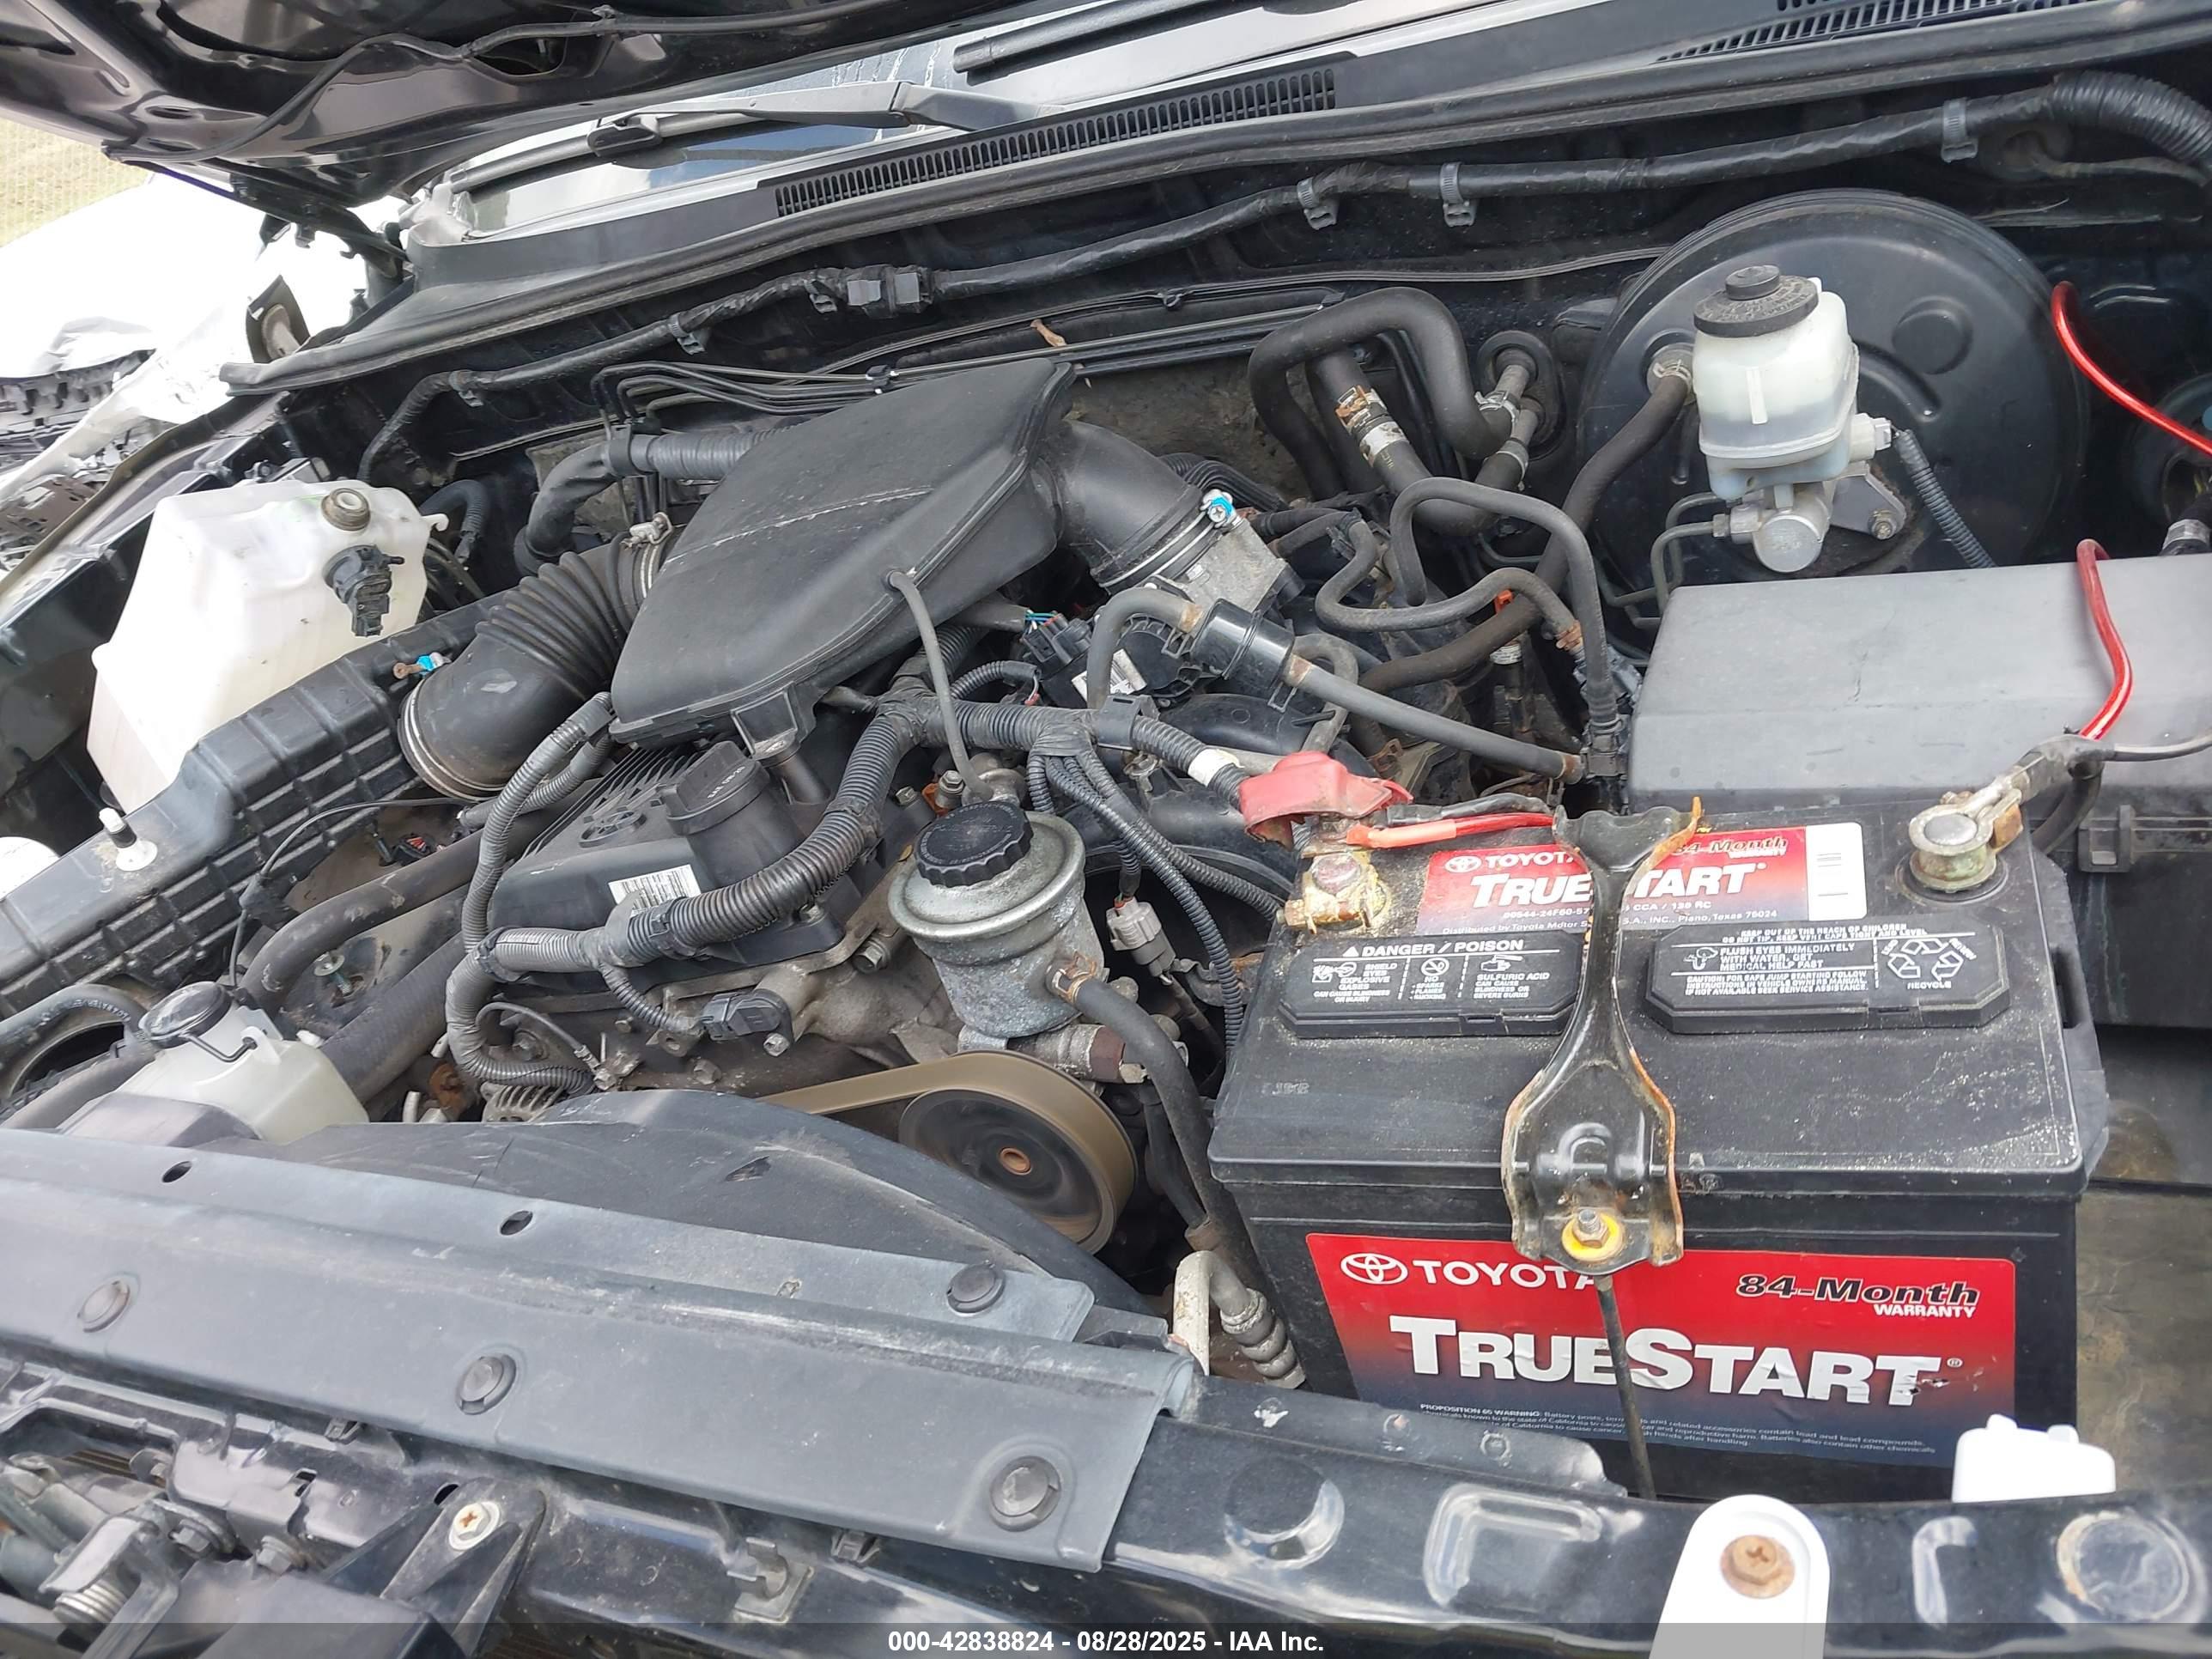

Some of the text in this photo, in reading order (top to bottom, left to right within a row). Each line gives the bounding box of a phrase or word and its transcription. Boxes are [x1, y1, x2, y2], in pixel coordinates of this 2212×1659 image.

[1486, 852, 1574, 868] TOYOT
[1443, 925, 1496, 934] Distributed
[1512, 922, 1544, 931] Toyota
[1713, 912, 1741, 921] Texas
[1862, 923, 1906, 932] CHILDREN
[1362, 945, 1435, 957] DANGER
[1455, 939, 1523, 953] POISON
[1720, 946, 1754, 956] FLUSH
[1784, 943, 1855, 953] IMMEDIATELY
[1364, 962, 1398, 970] SHIELD
[1720, 960, 1823, 971] MEDICAL HELP FAST
[1527, 972, 1550, 981] ACID
[1757, 979, 1790, 988] VEHICLE
[1907, 981, 1952, 989] RECYCLE
[1736, 1273, 1980, 1306] 84-Month
[1874, 1304, 1977, 1319] WARRANTY
[1420, 1403, 1480, 1413] PROPOSITION
[1703, 1425, 1757, 1434] accessories
[1760, 1434, 1801, 1443] Batteries
